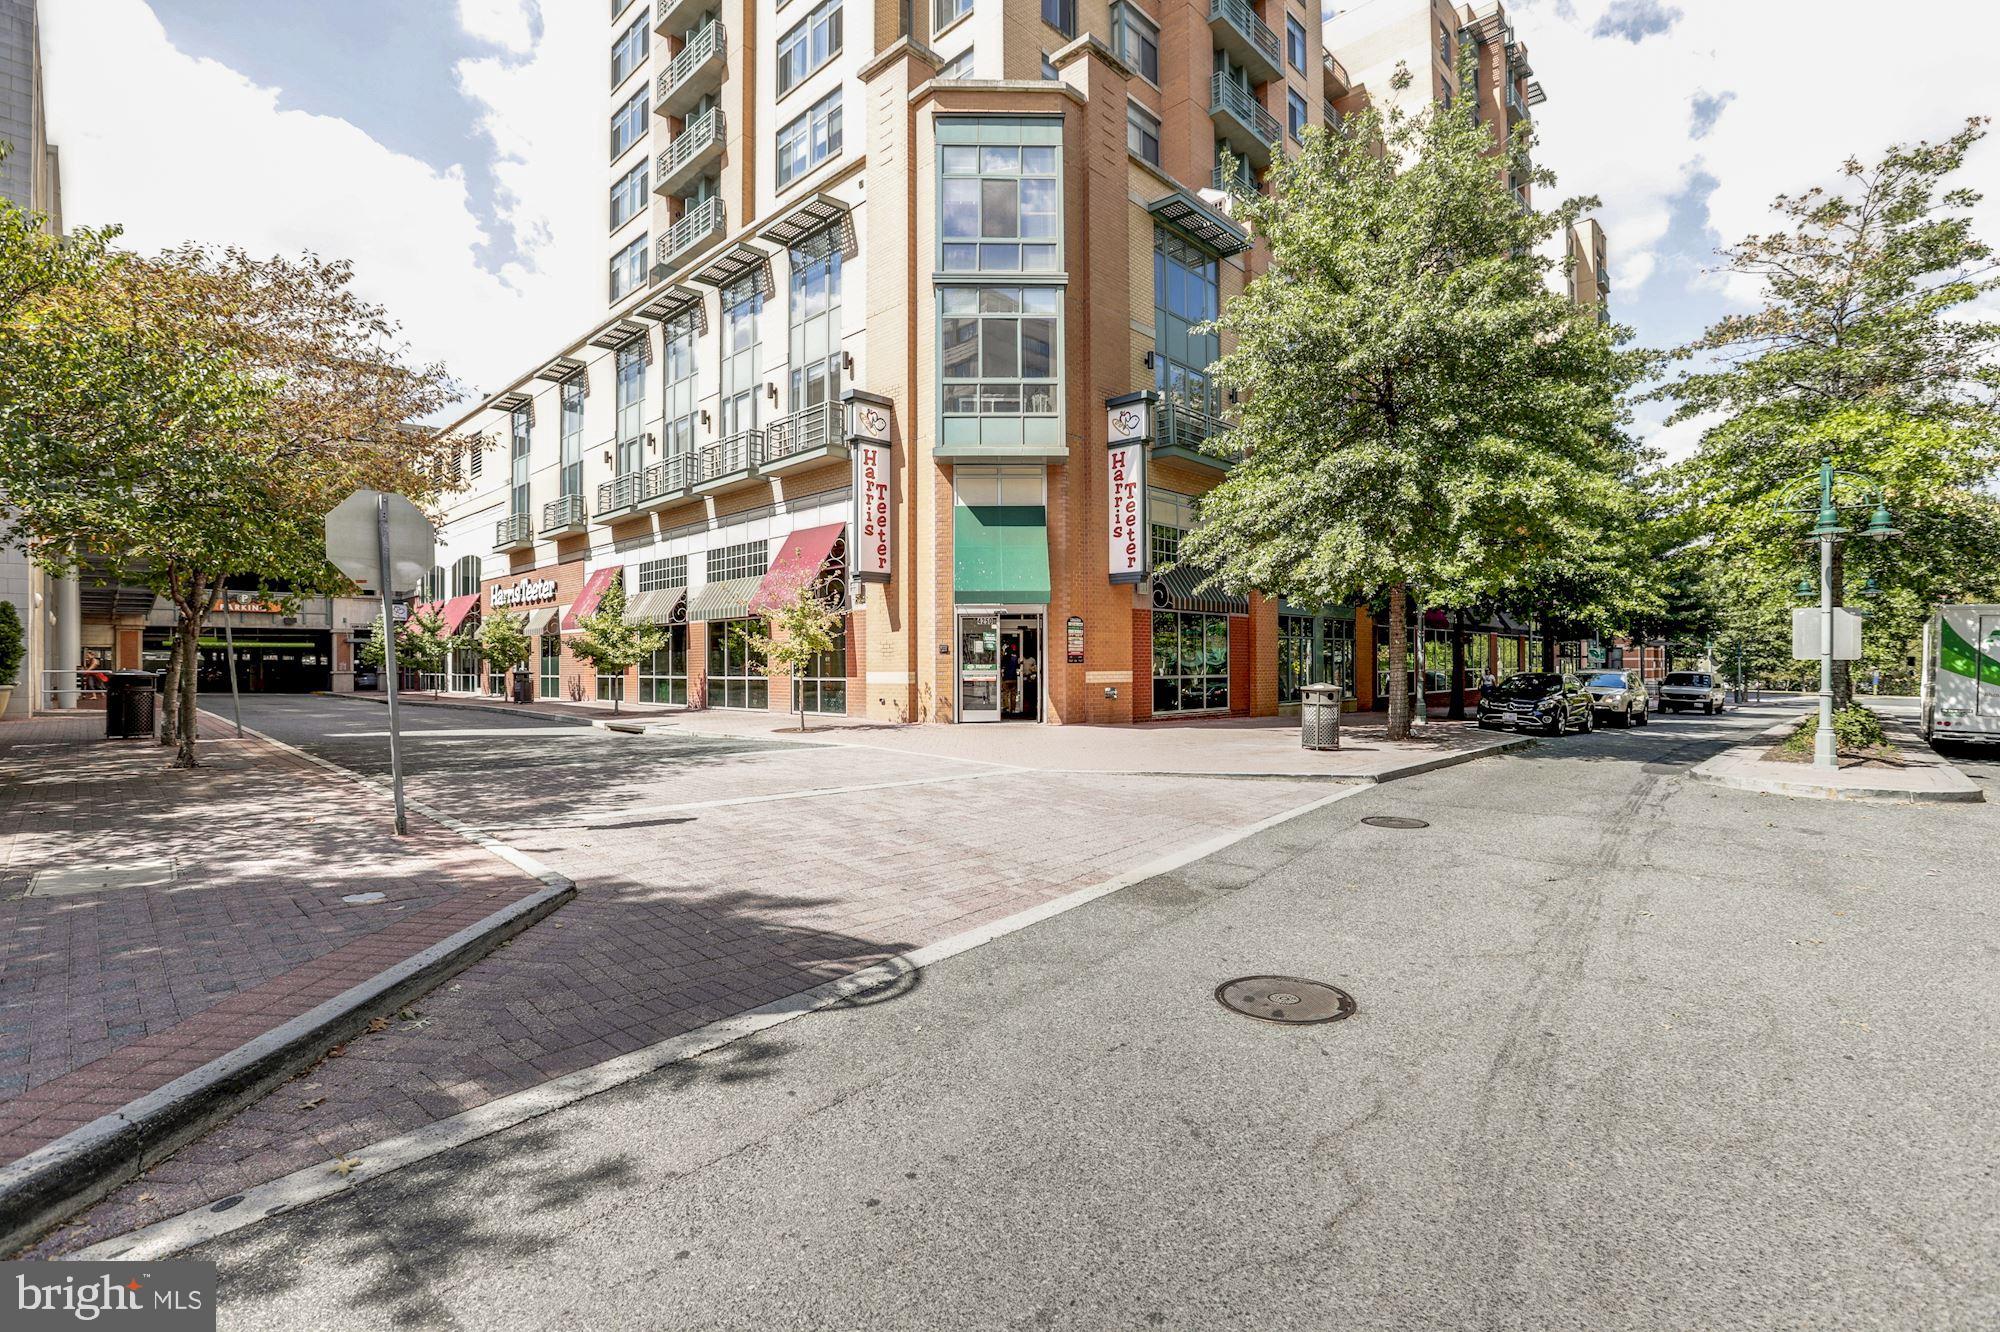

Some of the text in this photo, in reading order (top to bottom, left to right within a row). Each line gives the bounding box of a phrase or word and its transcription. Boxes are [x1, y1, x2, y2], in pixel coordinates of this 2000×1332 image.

[863, 449, 877, 536] Harris
[876, 483, 887, 568] Teeter
[1112, 451, 1125, 538] Harris
[1125, 482, 1136, 568] Teeter
[490, 577, 555, 606] Harris Teeter
